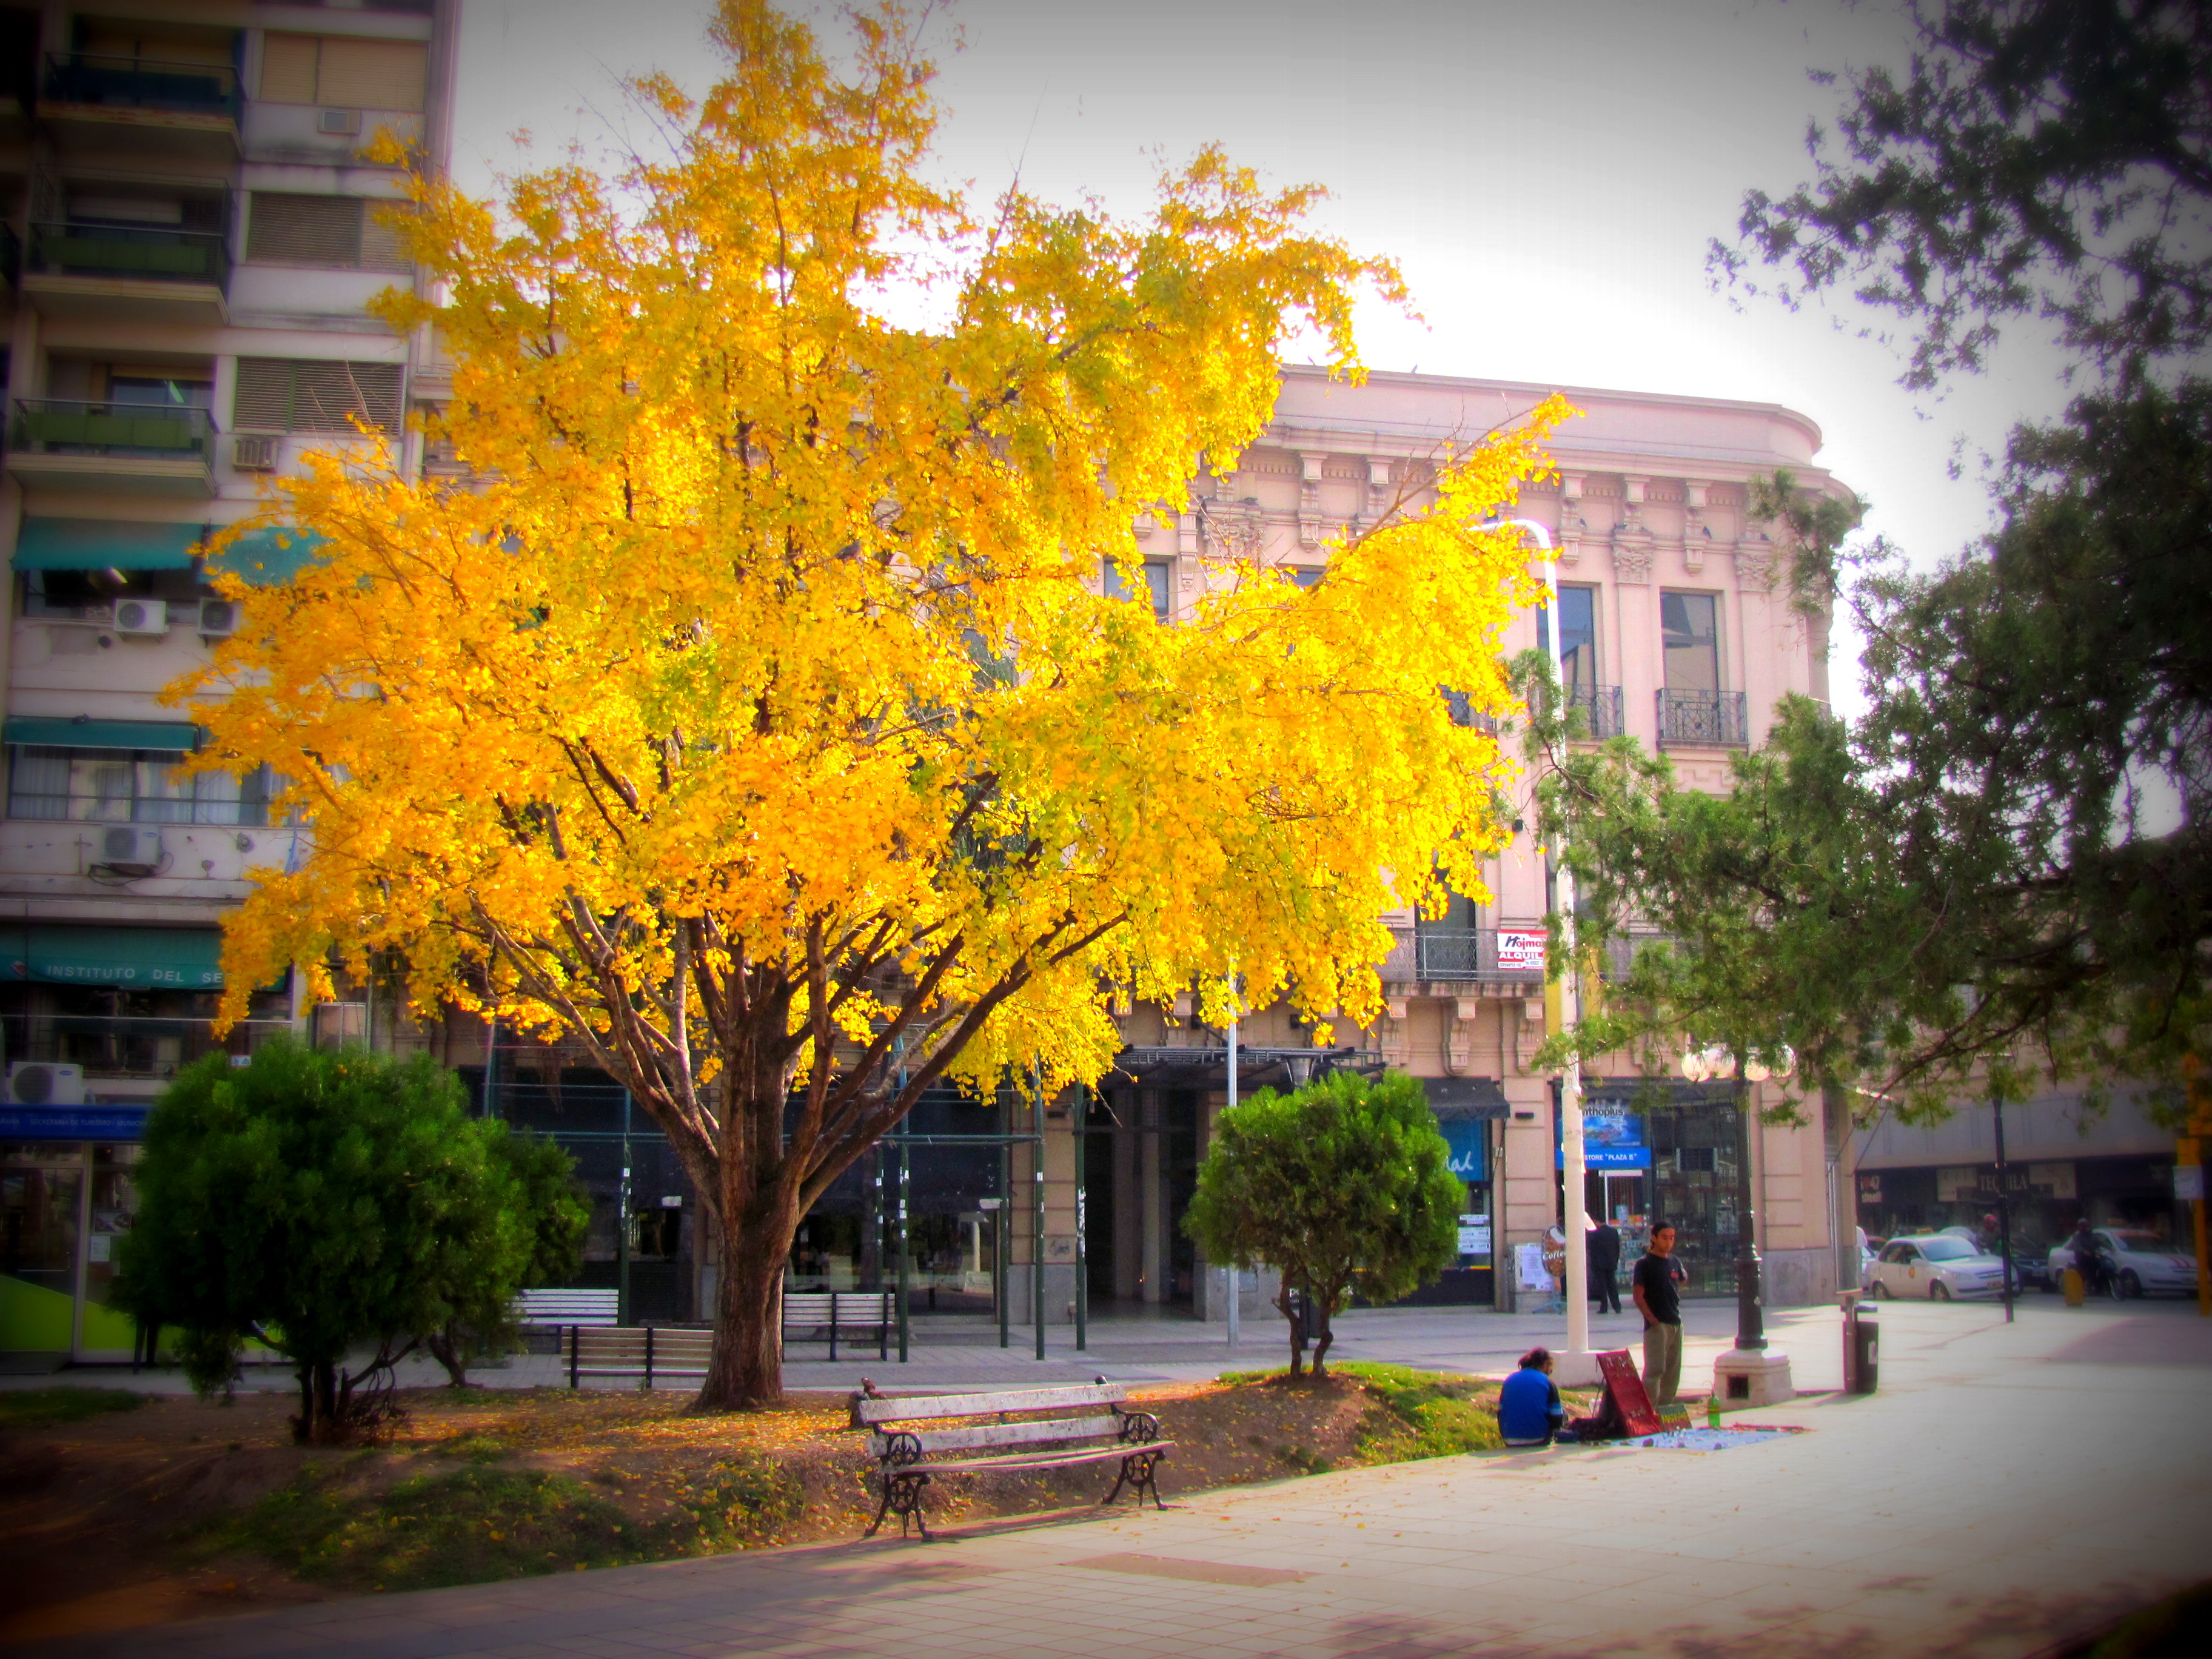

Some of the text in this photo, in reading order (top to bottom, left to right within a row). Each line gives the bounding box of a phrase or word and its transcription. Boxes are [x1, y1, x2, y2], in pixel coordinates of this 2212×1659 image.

[1504, 936, 1543, 950] Hojma
[47, 965, 232, 983] INSTITUTO DEL SE
[1543, 1250, 1566, 1261] Coffe
